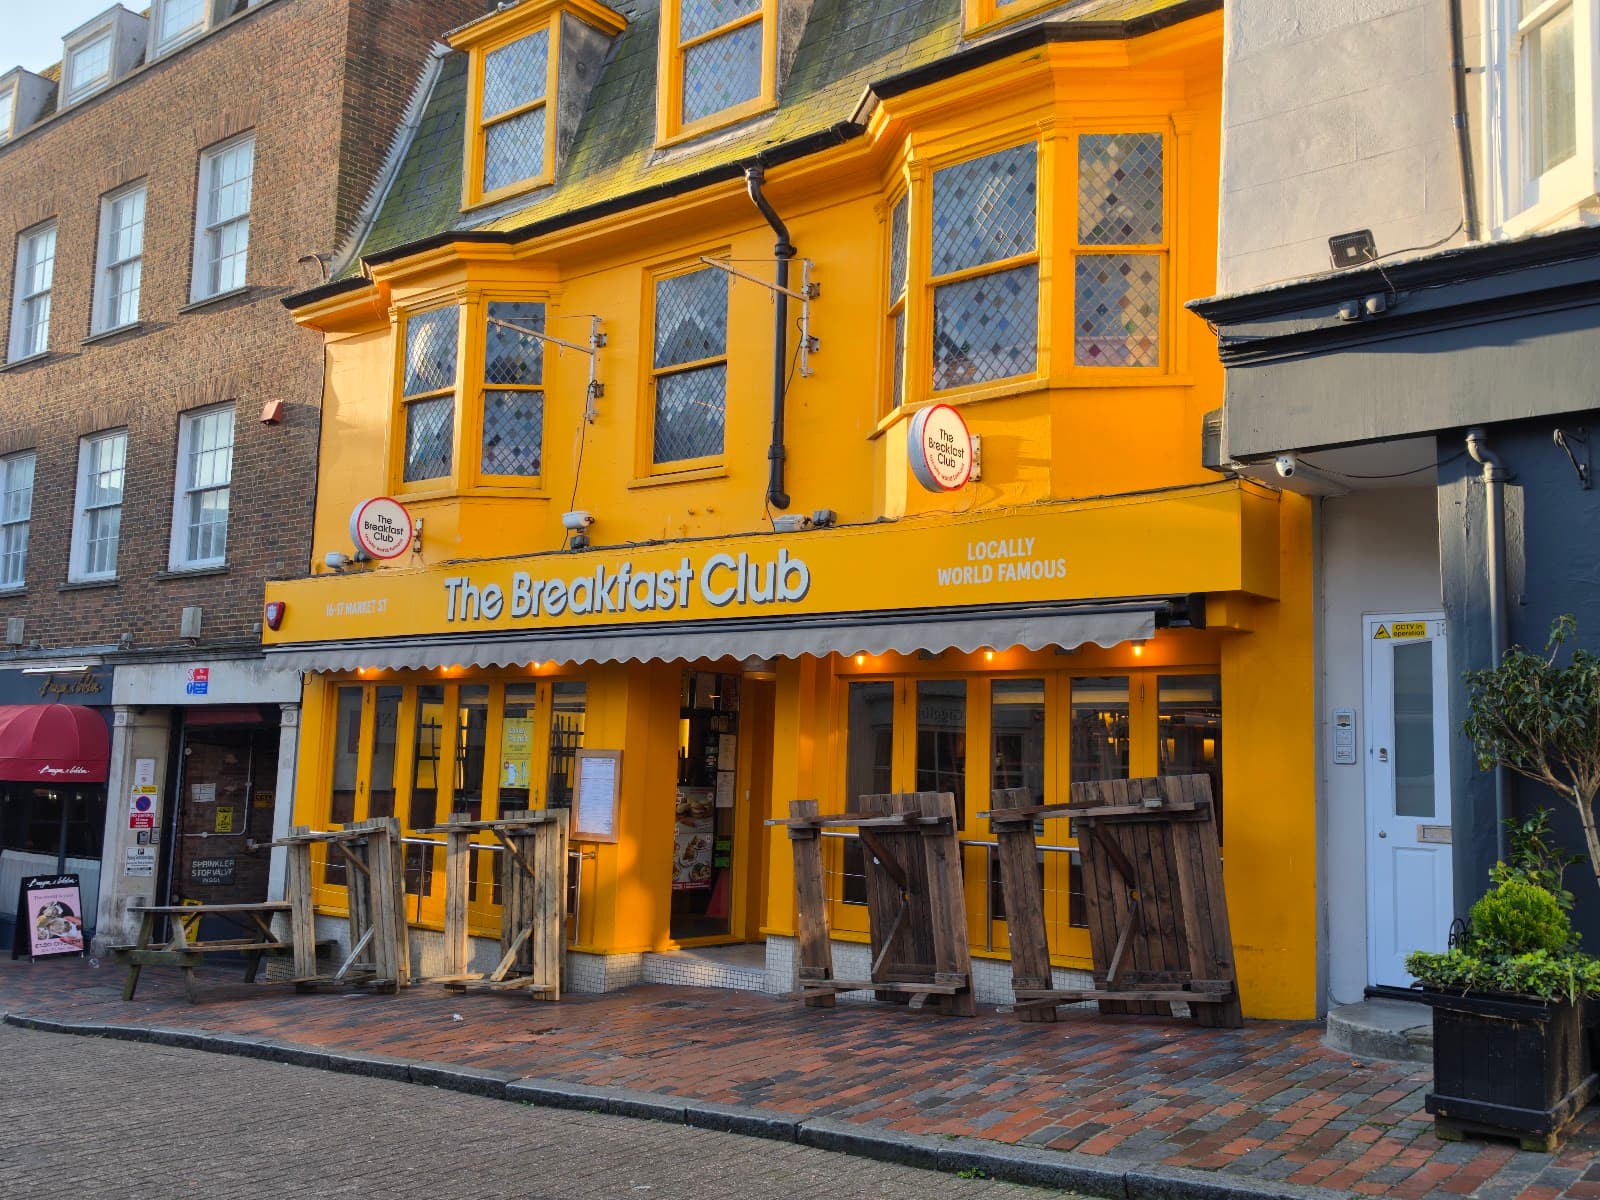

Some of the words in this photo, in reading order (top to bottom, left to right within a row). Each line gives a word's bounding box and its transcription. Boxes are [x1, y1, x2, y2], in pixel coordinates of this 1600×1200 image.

[940, 428, 954, 443] The
[928, 437, 965, 459] Breakfast
[937, 452, 956, 468] Club
[377, 514, 392, 525] The
[364, 520, 403, 536] Breakfast
[373, 531, 394, 543] Club
[966, 537, 1036, 561] LOCALLY
[937, 565, 993, 586] WORLD
[997, 558, 1067, 582] FAMOUS
[444, 576, 504, 621] The
[511, 557, 694, 619] Breakfast
[701, 548, 810, 607] Club
[345, 599, 376, 616] MARKET
[377, 597, 387, 612] ST
[1393, 630, 1425, 638] operation
